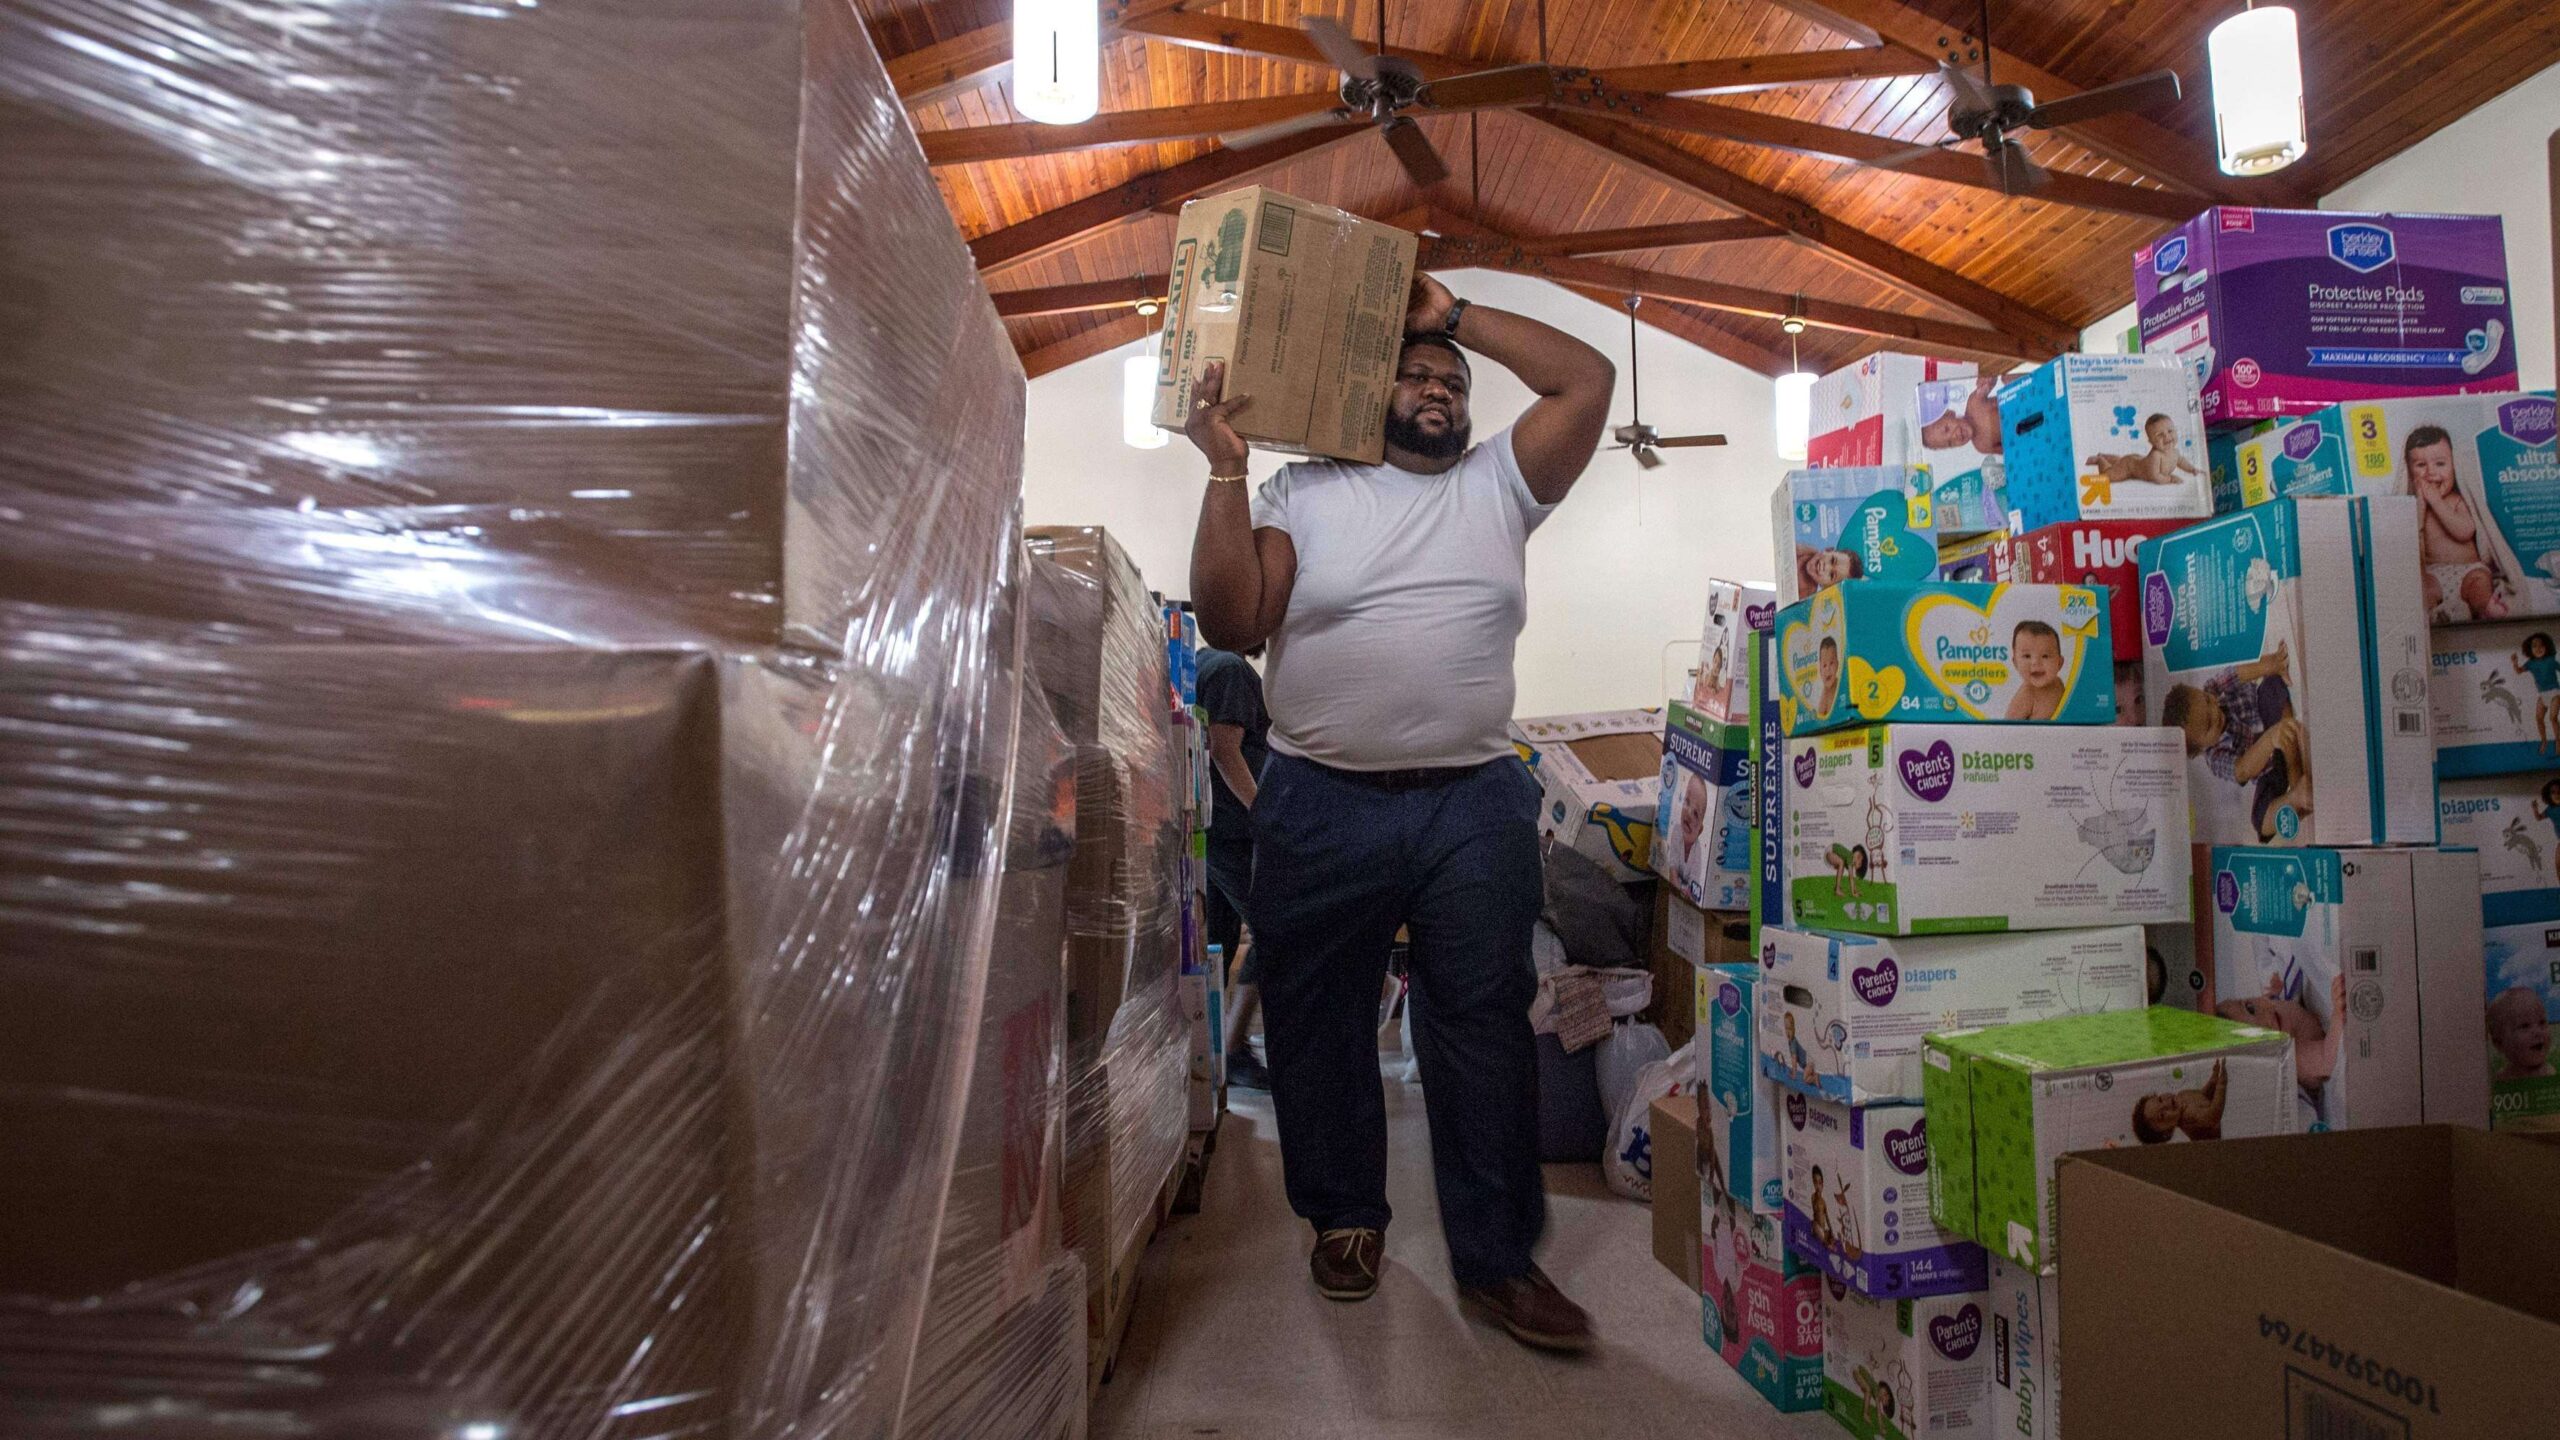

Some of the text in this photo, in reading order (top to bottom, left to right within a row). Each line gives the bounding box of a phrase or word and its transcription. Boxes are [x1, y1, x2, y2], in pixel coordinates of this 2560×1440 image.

[2309, 284, 2425, 301] Protective Pads
[1161, 250, 1187, 376] U-HAUL
[2143, 290, 2206, 329] Protective Pads
[2321, 354, 2426, 362] MAXIMUM ABSORBENCY
[1176, 366, 1188, 418] SMALL
[1184, 329, 1194, 360] BOX
[2510, 404, 2556, 418] berkley
[2361, 420, 2378, 439] 3
[2513, 417, 2556, 435] jensen
[2516, 450, 2557, 465] ultra
[2247, 458, 2258, 476] 3
[1863, 506, 1888, 573] Pampers
[2147, 584, 2159, 633] berkley
[2155, 581, 2167, 633] jensen
[2176, 584, 2188, 629] ultra
[2184, 551, 2199, 651] absorbent
[1937, 636, 2008, 663] Pampers
[2432, 650, 2478, 667] apers
[1793, 651, 1818, 669] Pampers
[1944, 665, 2006, 678] swaddlers
[1868, 682, 1879, 699] 2
[1901, 696, 1920, 710] 84
[1819, 753, 1852, 768] Diapers
[1872, 744, 1880, 763] 5
[1962, 751, 2034, 771] Diapers
[1907, 751, 1951, 779] Parent's
[1917, 775, 1948, 792] CHOICE
[1963, 772, 1999, 782] Pañales
[2441, 798, 2500, 815] Diapers
[1830, 963, 1836, 976] 4
[1858, 966, 1896, 990] Parent's
[1905, 968, 1957, 983] Diapers
[1867, 983, 1894, 999] CHOICE
[1809, 1107, 1838, 1130] Diapers
[1891, 1129, 1926, 1157] Parent'
[1901, 1149, 1927, 1166] CHOIC
[1911, 1259, 1933, 1273] 144
[1885, 1264, 1902, 1290] 3
[1911, 1272, 1938, 1281] Diapers
[1748, 1288, 1770, 1312] ups
[1748, 1305, 1775, 1336] easy
[1937, 1313, 1978, 1342] Parent's
[1797, 1333, 1823, 1346] AVE
[1946, 1334, 1975, 1352] CHOICE
[1751, 1346, 1778, 1384] Pampers
[2259, 1313, 2443, 1415] 1003944764
[1797, 1375, 1824, 1386] IGHT
